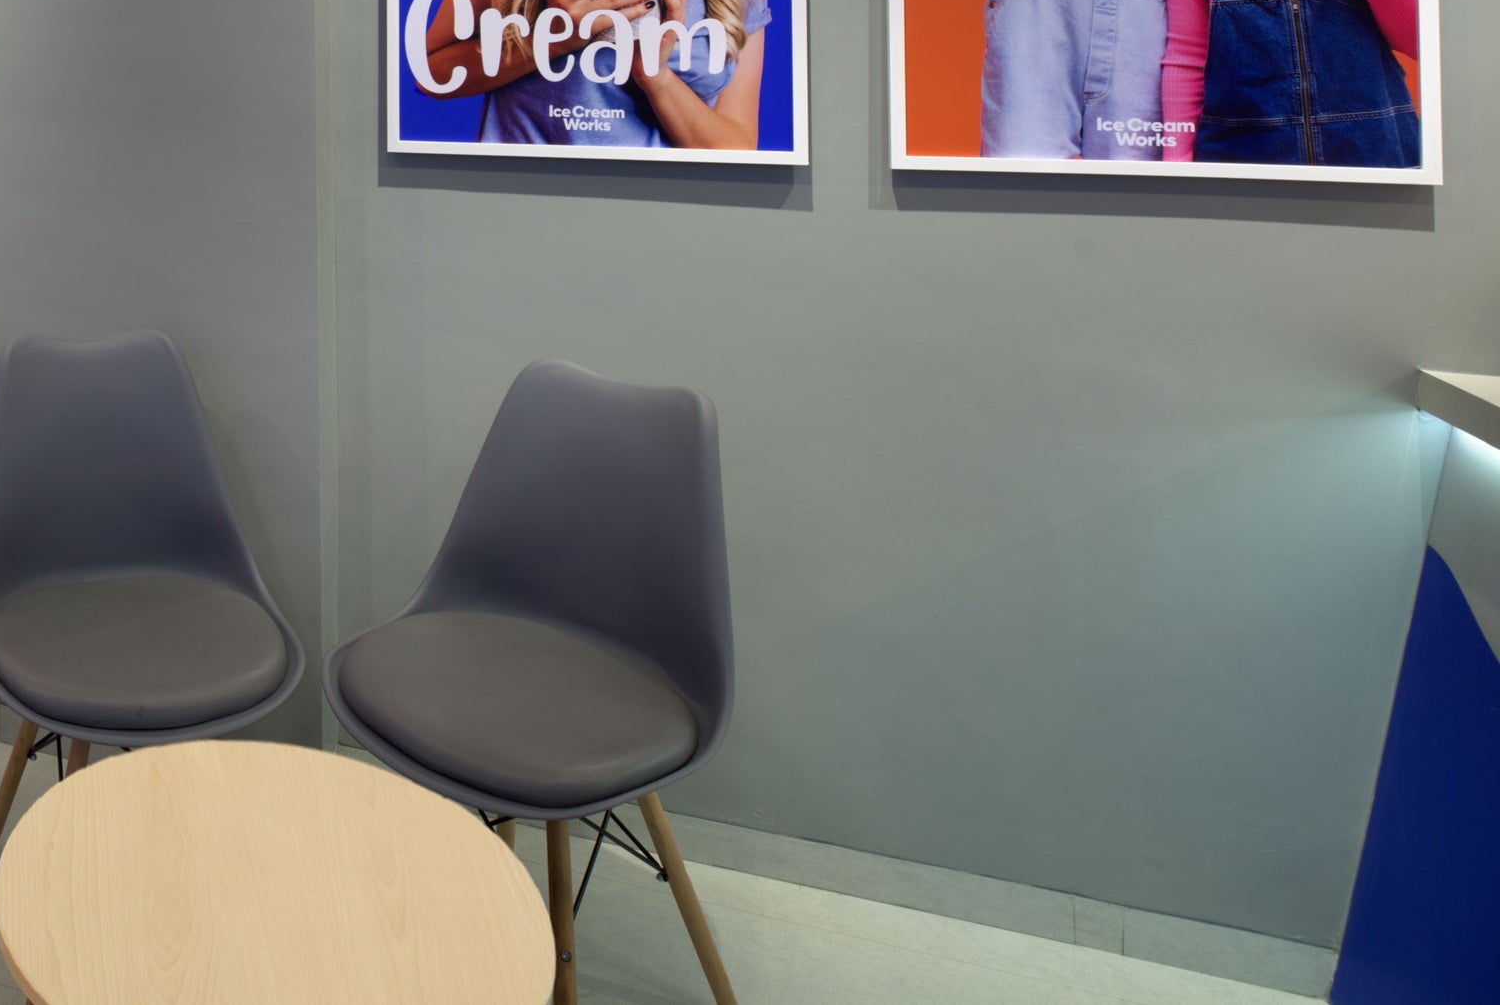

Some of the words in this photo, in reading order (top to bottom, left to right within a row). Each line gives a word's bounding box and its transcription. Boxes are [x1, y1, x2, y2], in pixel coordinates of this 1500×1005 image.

[548, 104, 571, 117] Ice
[572, 105, 626, 119] Cream
[563, 118, 611, 131] Works
[1096, 117, 1125, 131] Ice
[1126, 117, 1196, 133] Cream
[1115, 132, 1177, 147] Works
